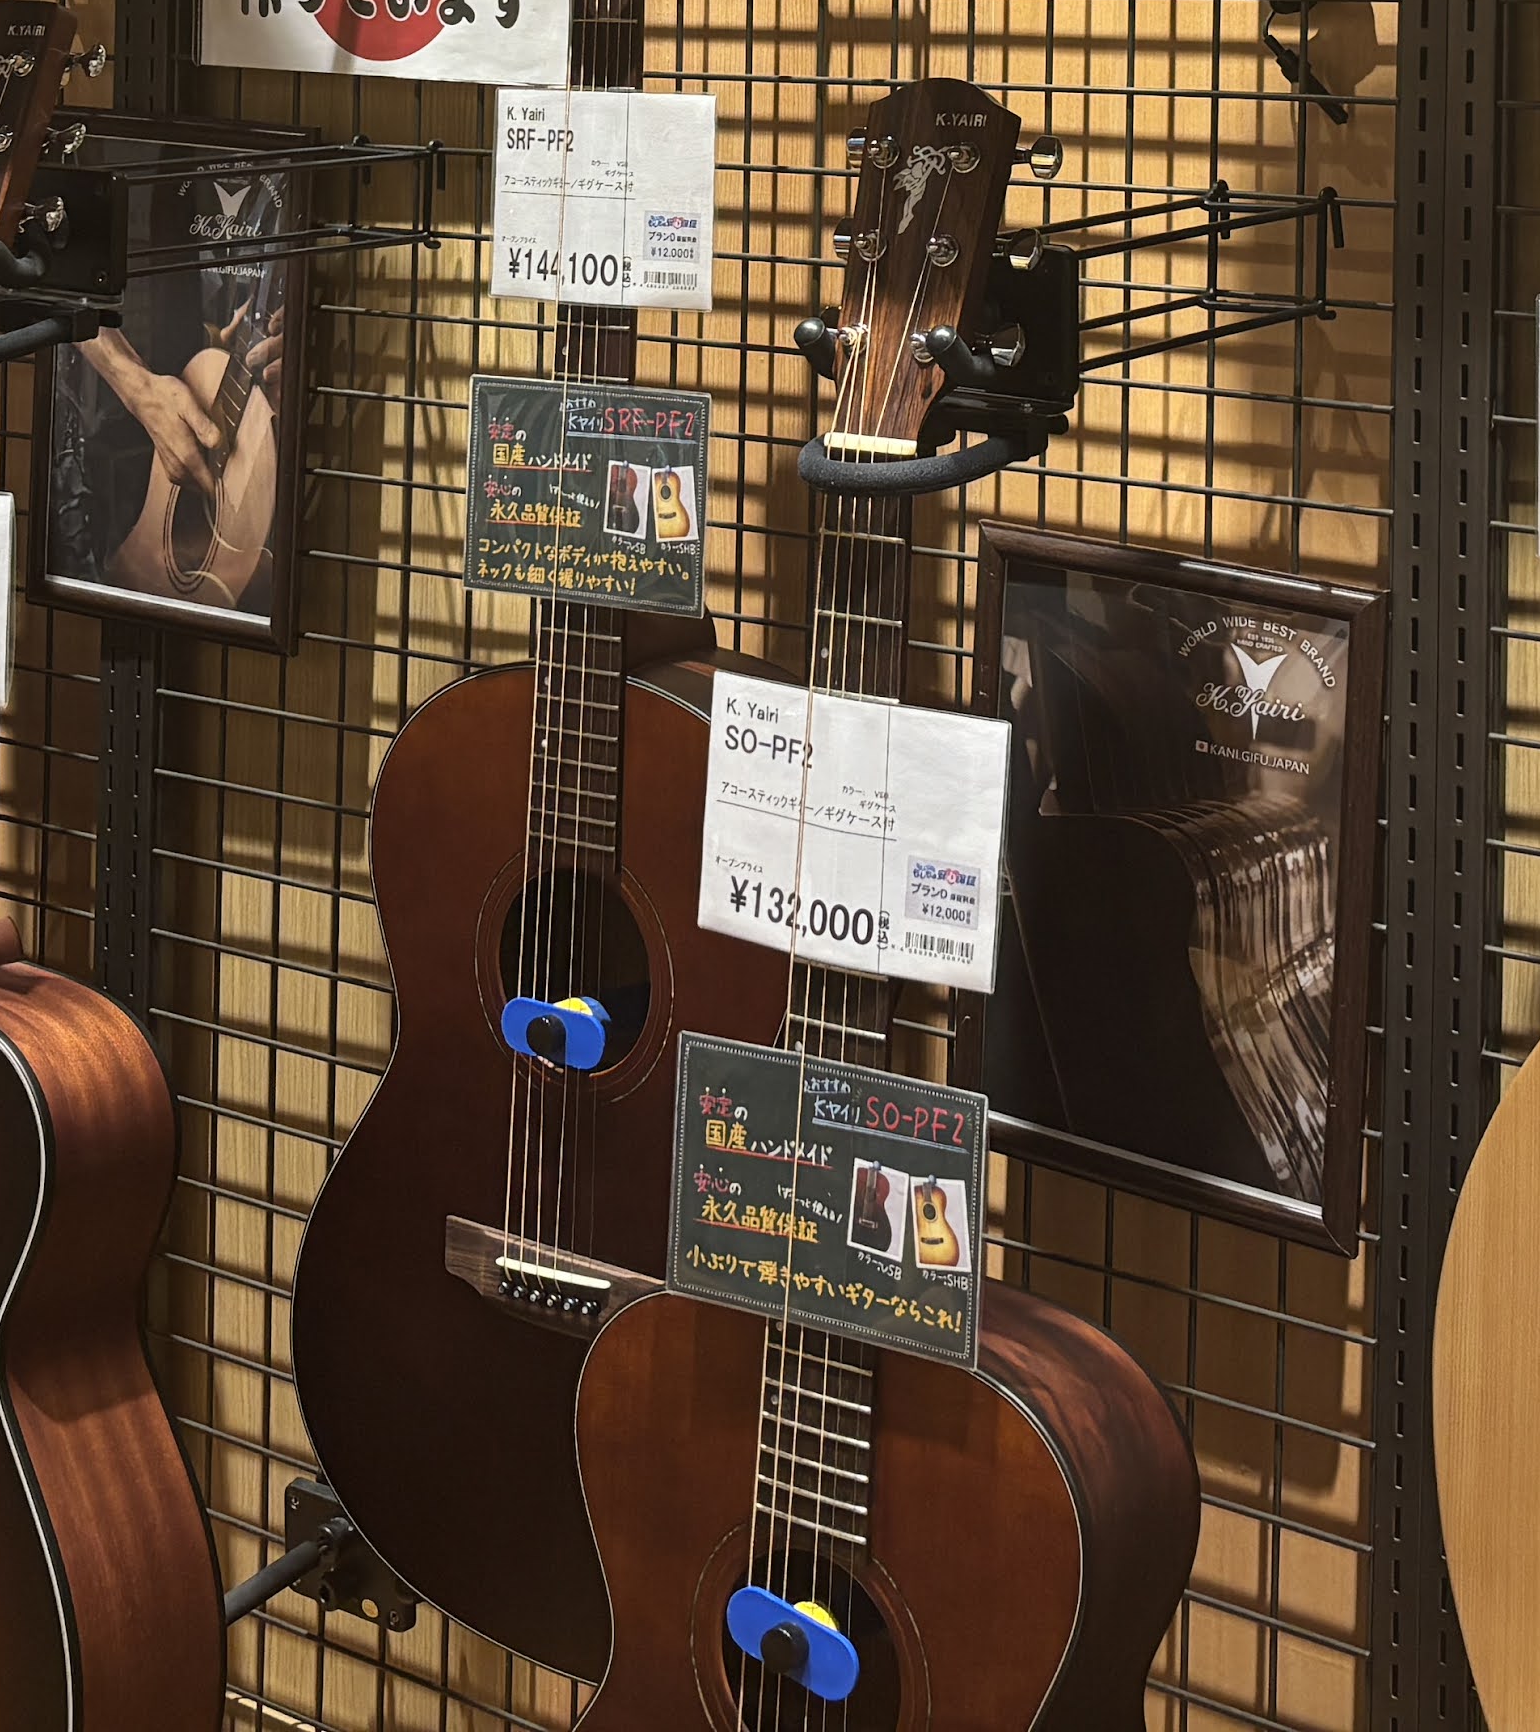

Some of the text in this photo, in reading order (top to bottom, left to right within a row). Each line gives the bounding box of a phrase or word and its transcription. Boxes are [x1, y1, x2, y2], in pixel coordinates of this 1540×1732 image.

[507, 106, 545, 122] K. Yairi
[935, 113, 988, 128] K.YAIRI
[506, 128, 574, 152] SRF-PF2
[509, 246, 619, 287] ¥144,100
[1178, 616, 1336, 688] WORLD WIDE BEST BRAND
[726, 697, 779, 724] K. Yairi
[724, 724, 814, 769] SO-PF2
[730, 874, 875, 946] ¥132,000
[922, 903, 965, 922] ¥12,000
[699, 1092, 749, 1120] 安定の
[865, 1095, 966, 1147] SO-PF2
[693, 1169, 742, 1196] 安心の
